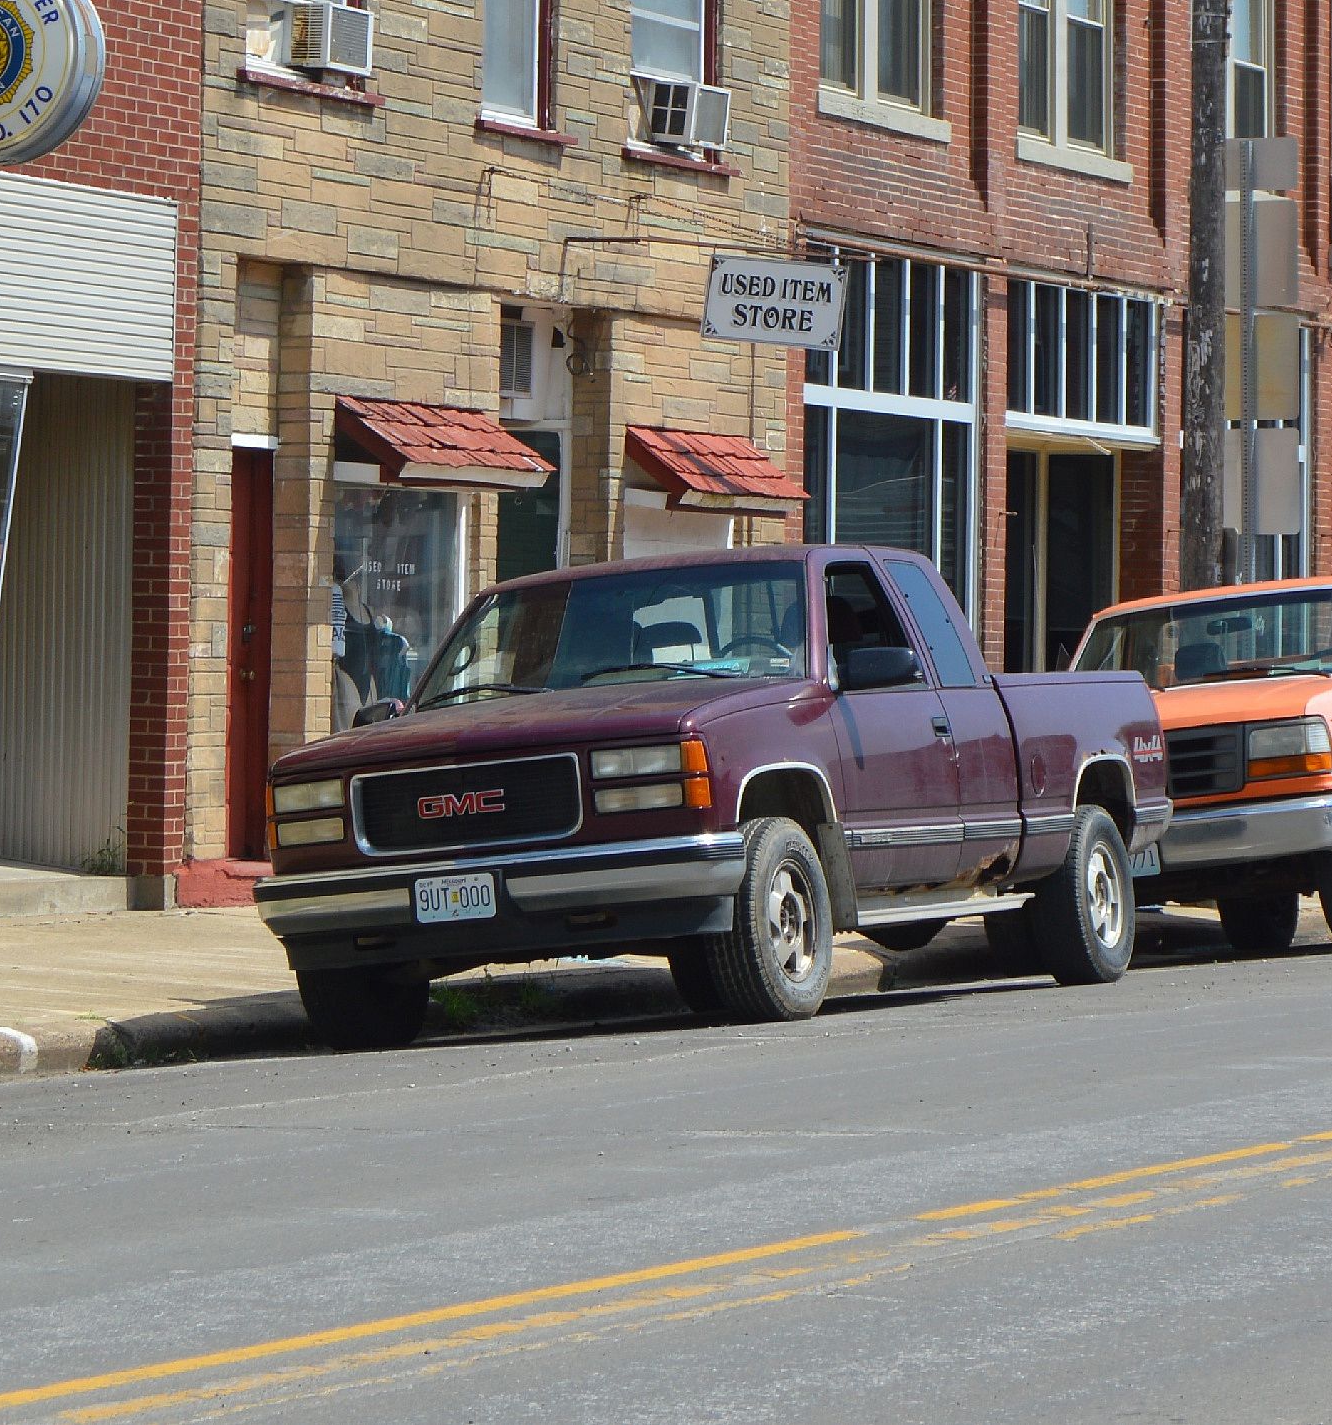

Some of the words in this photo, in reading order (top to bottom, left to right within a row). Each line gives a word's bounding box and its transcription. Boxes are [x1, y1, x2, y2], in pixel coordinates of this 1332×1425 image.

[19, 86, 53, 124] 170
[721, 273, 776, 297] USED
[781, 278, 832, 303] ITEM
[732, 303, 814, 332] STORE
[397, 563, 416, 575] ITEM
[418, 788, 505, 820] GMC
[419, 887, 450, 912] 9UT
[459, 884, 491, 909] 000
